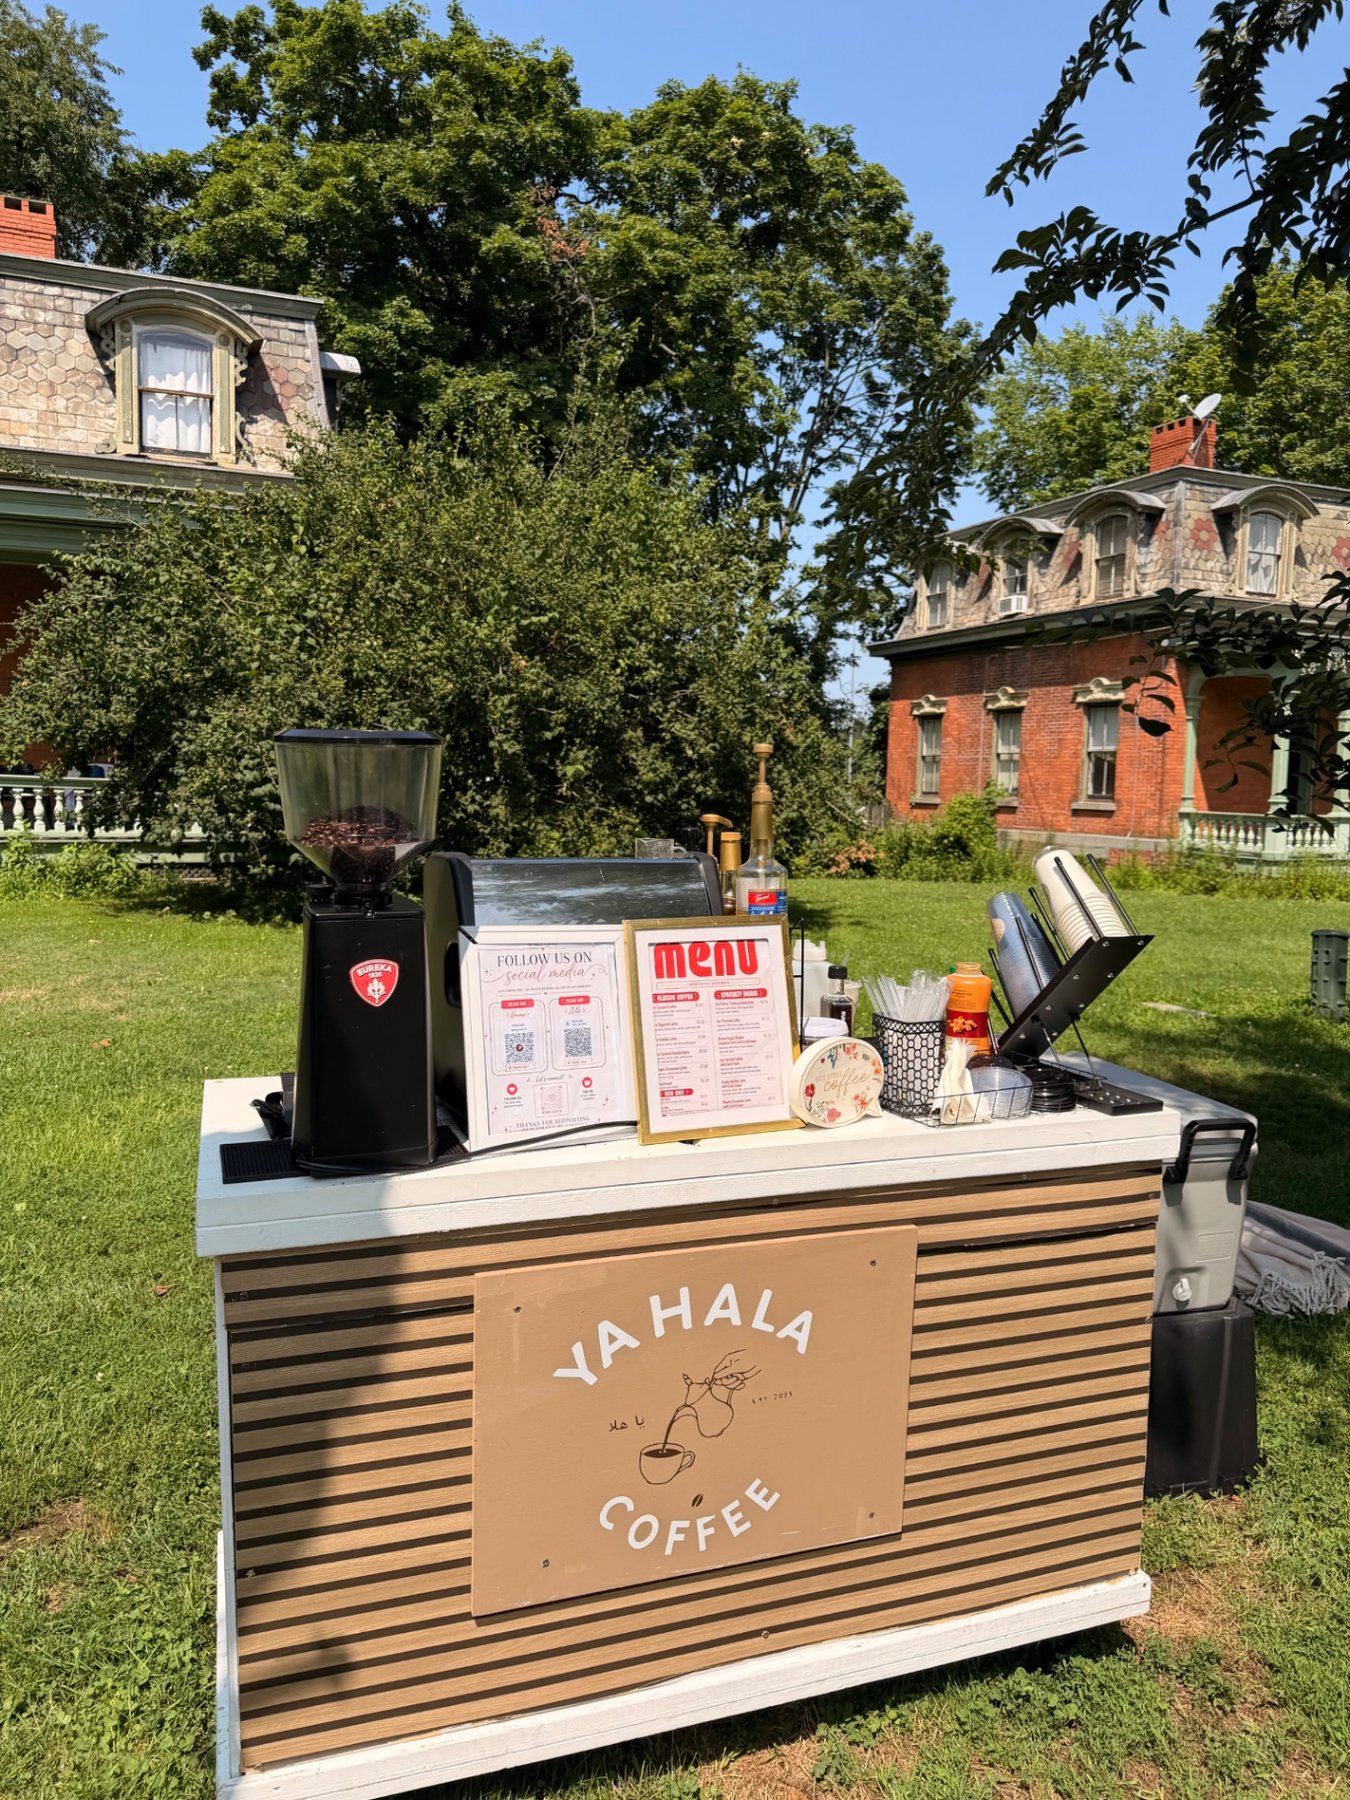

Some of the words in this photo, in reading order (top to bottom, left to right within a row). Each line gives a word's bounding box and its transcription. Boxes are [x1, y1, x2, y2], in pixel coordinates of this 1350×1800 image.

[497, 954, 551, 967] FOLLOW
[555, 952, 570, 964] US
[574, 951, 592, 963] ON
[356, 964, 392, 976] EUREKA
[504, 964, 546, 986] social
[549, 963, 586, 982] media
[824, 1068, 870, 1098] coffee
[553, 1319, 641, 1386] YA
[648, 1282, 814, 1355] HALA
[608, 1419, 628, 1432] هلا
[635, 1416, 645, 1429] يا
[599, 1477, 781, 1556] COFFEE
